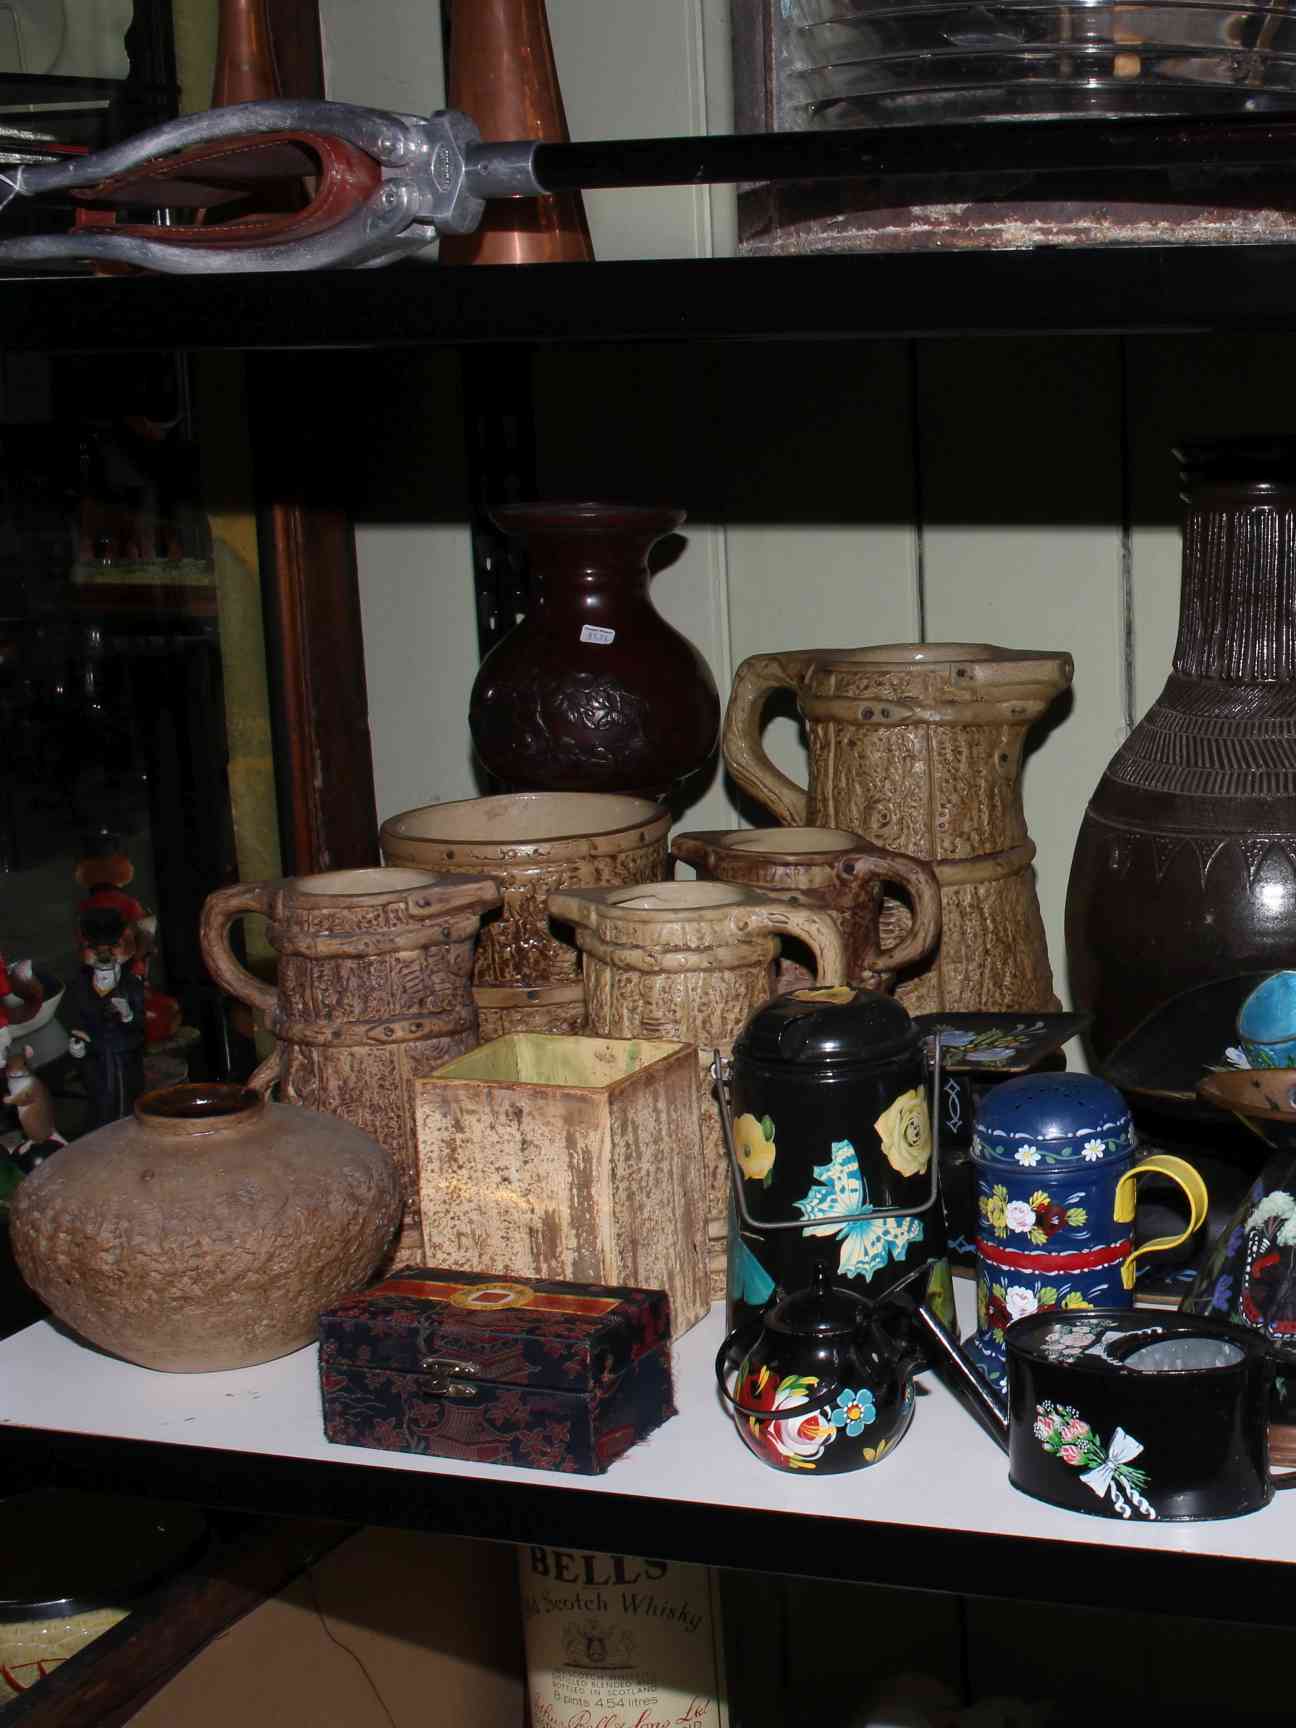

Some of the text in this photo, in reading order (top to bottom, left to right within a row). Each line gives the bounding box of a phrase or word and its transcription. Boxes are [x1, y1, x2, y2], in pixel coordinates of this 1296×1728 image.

[543, 1591, 608, 1613] Scotch
[621, 1592, 703, 1632] Whisky
[563, 1696, 590, 1708] pints
[628, 1696, 659, 1707] litres
